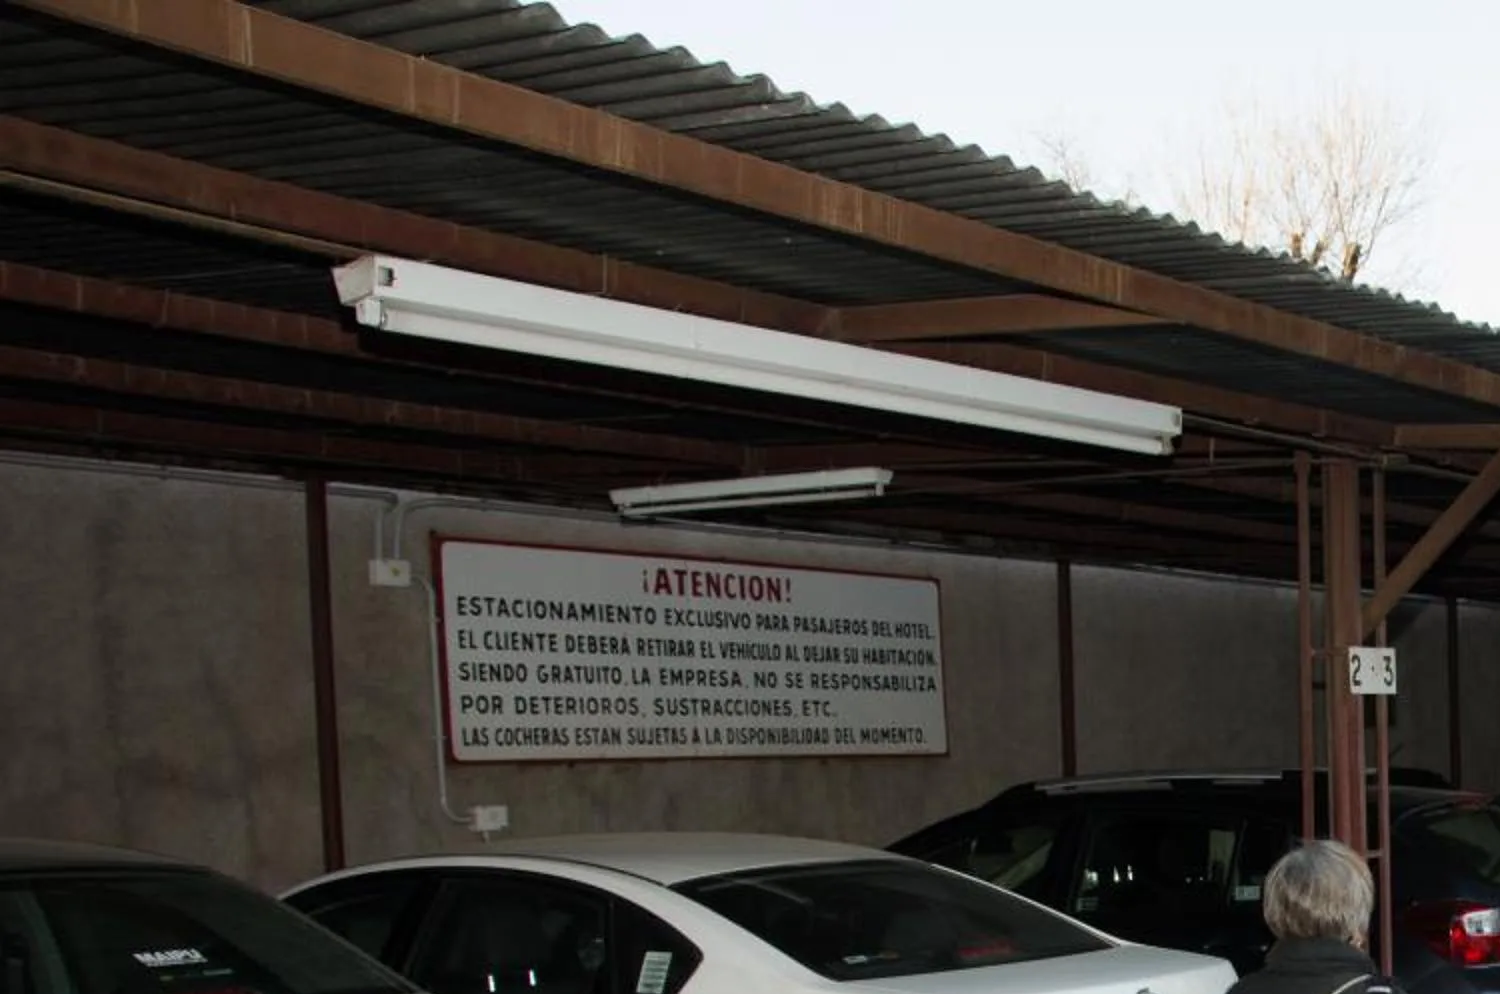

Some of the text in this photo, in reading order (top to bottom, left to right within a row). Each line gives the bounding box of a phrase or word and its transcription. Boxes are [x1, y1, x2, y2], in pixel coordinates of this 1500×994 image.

[456, 595, 657, 626] ESTACIONAMIENTO
[663, 607, 751, 631] EXCLUSIVO
[755, 612, 789, 633] PARA
[793, 614, 869, 639] PASAJEROS
[872, 620, 894, 638] DEL
[458, 629, 477, 650] EL
[483, 630, 559, 653] CLIENTE
[637, 637, 696, 658] RETIRAR
[700, 640, 716, 660] EL
[785, 645, 801, 663] AL
[803, 645, 841, 664] DEJAR
[843, 647, 860, 666] SU
[458, 662, 529, 683] SIENDO
[631, 667, 651, 686] LA
[753, 671, 778, 689] NO
[784, 672, 804, 689] SE
[810, 673, 938, 693] RESPONSABILIZA
[460, 694, 504, 715] POR
[461, 727, 490, 747] LAS
[494, 726, 570, 747] COCHERAS
[574, 727, 622, 747] ESTAN
[626, 727, 688, 746] SUJETAS
[691, 727, 701, 744] A
[704, 727, 723, 746] LA
[726, 726, 830, 745] DISPONIBILIDAD
[834, 726, 855, 745] DEL
